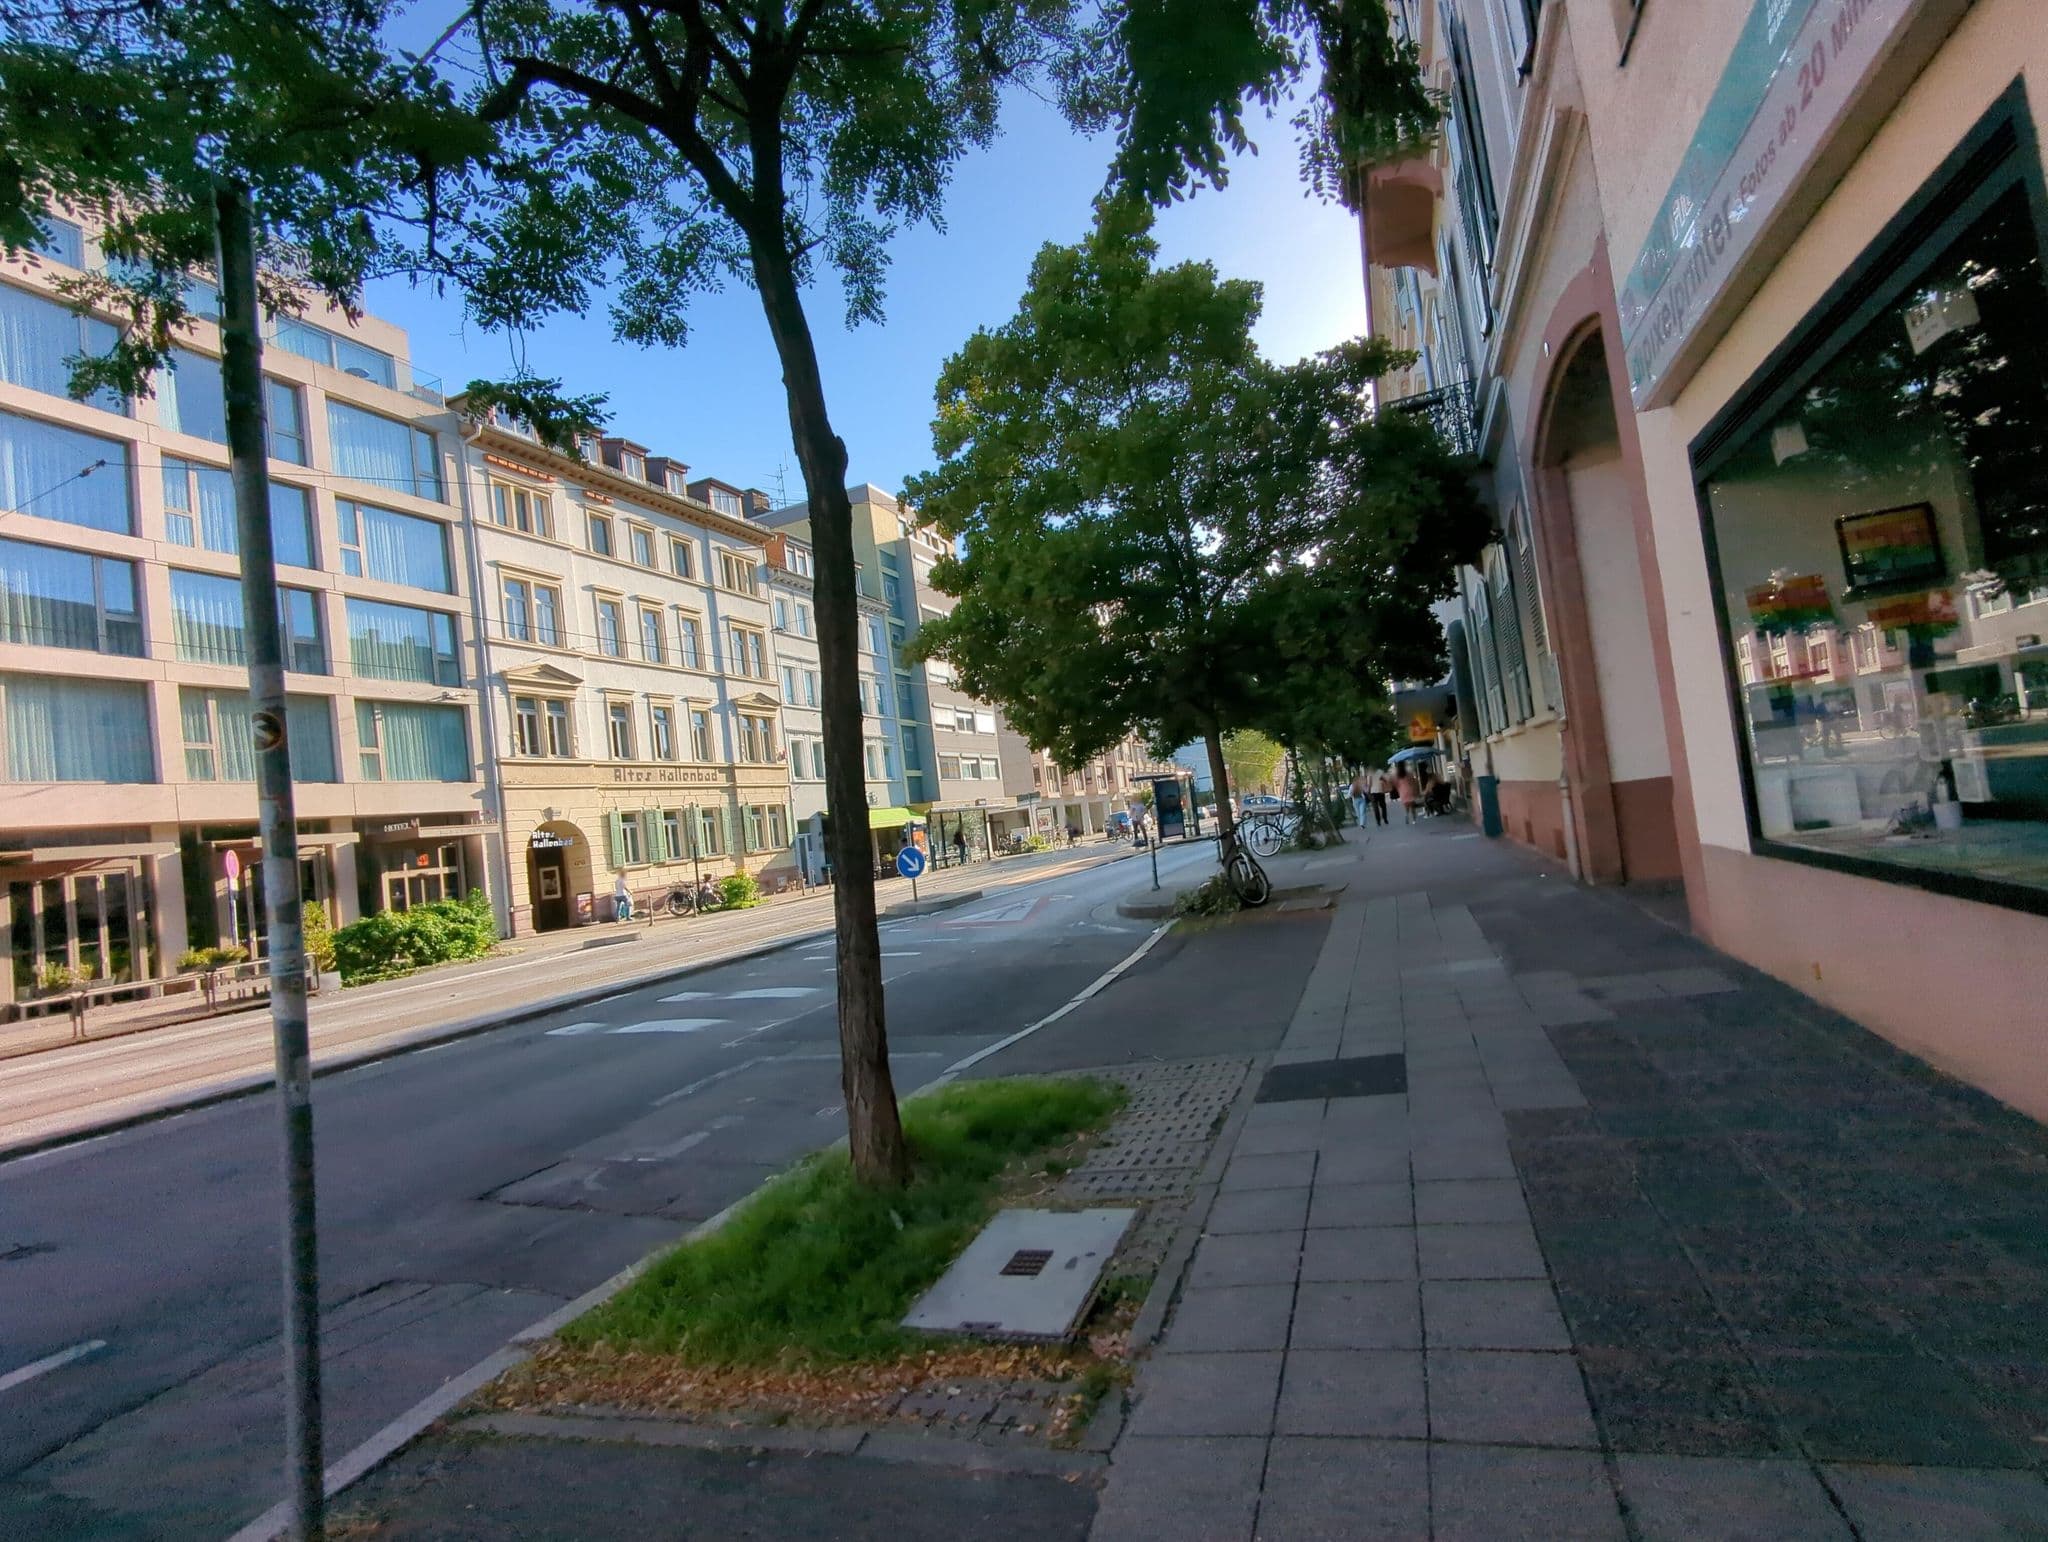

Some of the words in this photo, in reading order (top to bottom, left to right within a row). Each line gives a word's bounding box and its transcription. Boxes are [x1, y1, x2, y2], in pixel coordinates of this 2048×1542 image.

[1739, 139, 1777, 206] Fotos
[1778, 104, 1797, 146] ab
[1797, 40, 1826, 113] 20
[614, 768, 652, 782] Altes
[659, 767, 718, 782] Hallenbad
[383, 822, 412, 833] HOTEL
[532, 831, 556, 840] Altes
[533, 838, 574, 848] Hallenbad
